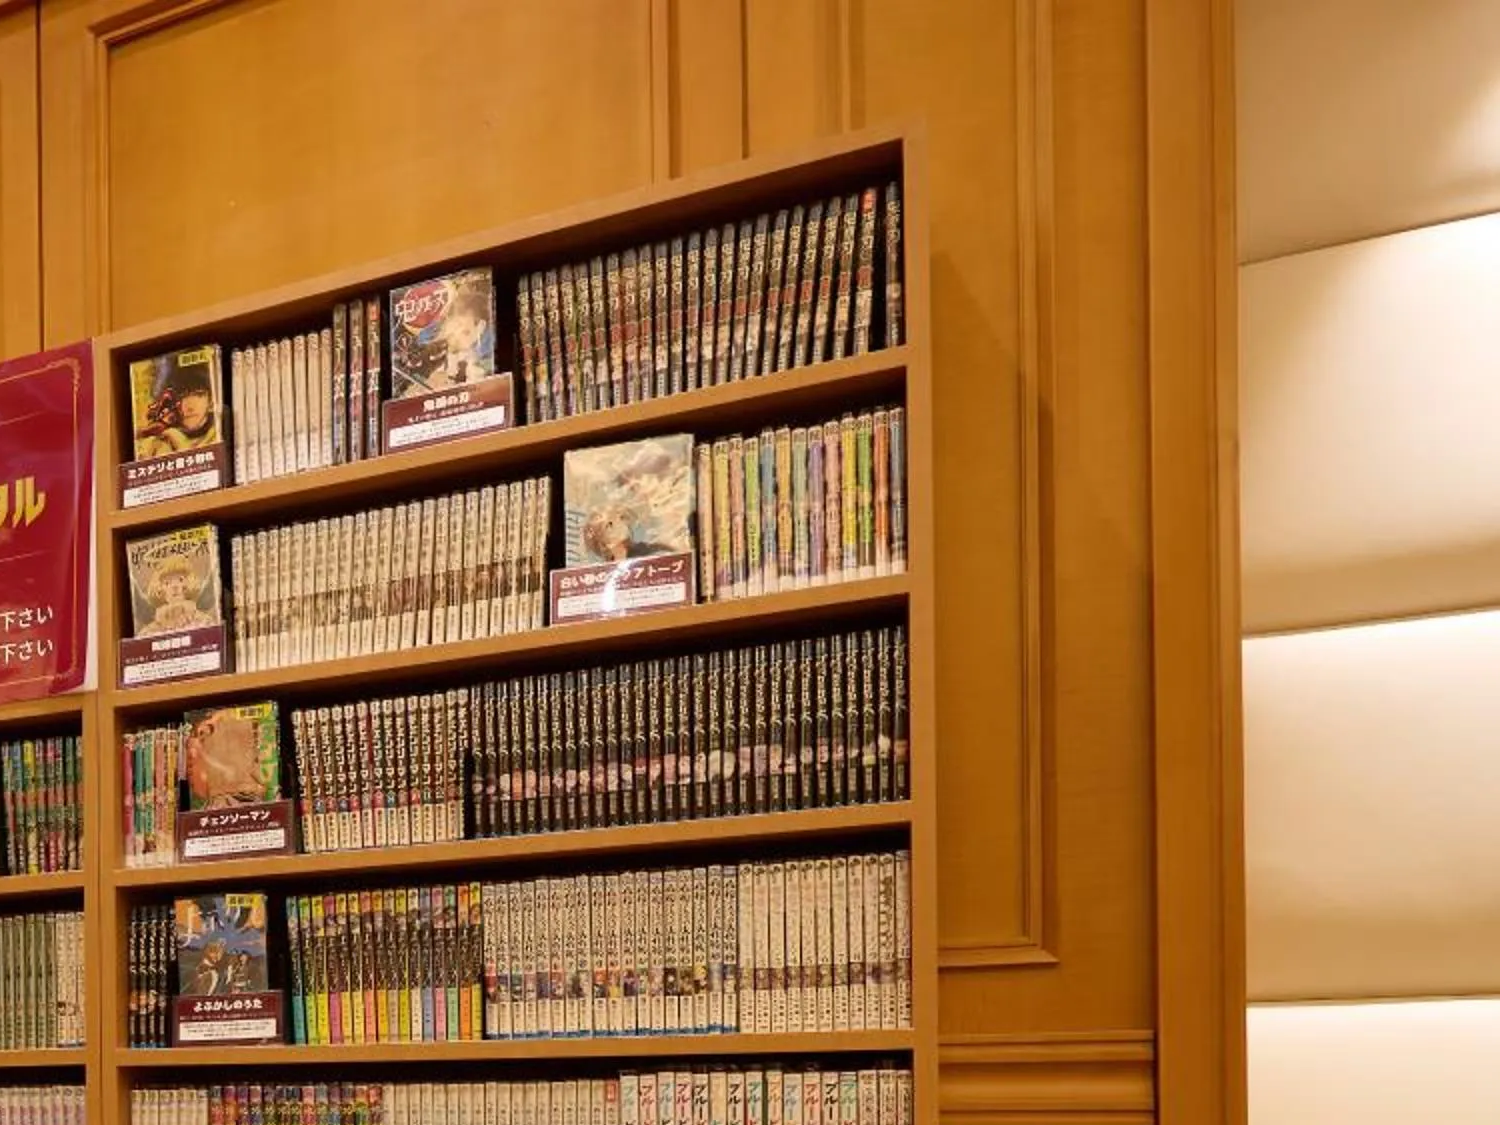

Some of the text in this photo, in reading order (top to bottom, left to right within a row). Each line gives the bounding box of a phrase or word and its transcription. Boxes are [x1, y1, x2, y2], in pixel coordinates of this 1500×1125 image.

[560, 559, 685, 589] 白い砂のクアトープ
[200, 810, 271, 827] チェンソーマン
[194, 998, 263, 1013] よふかしのうた
